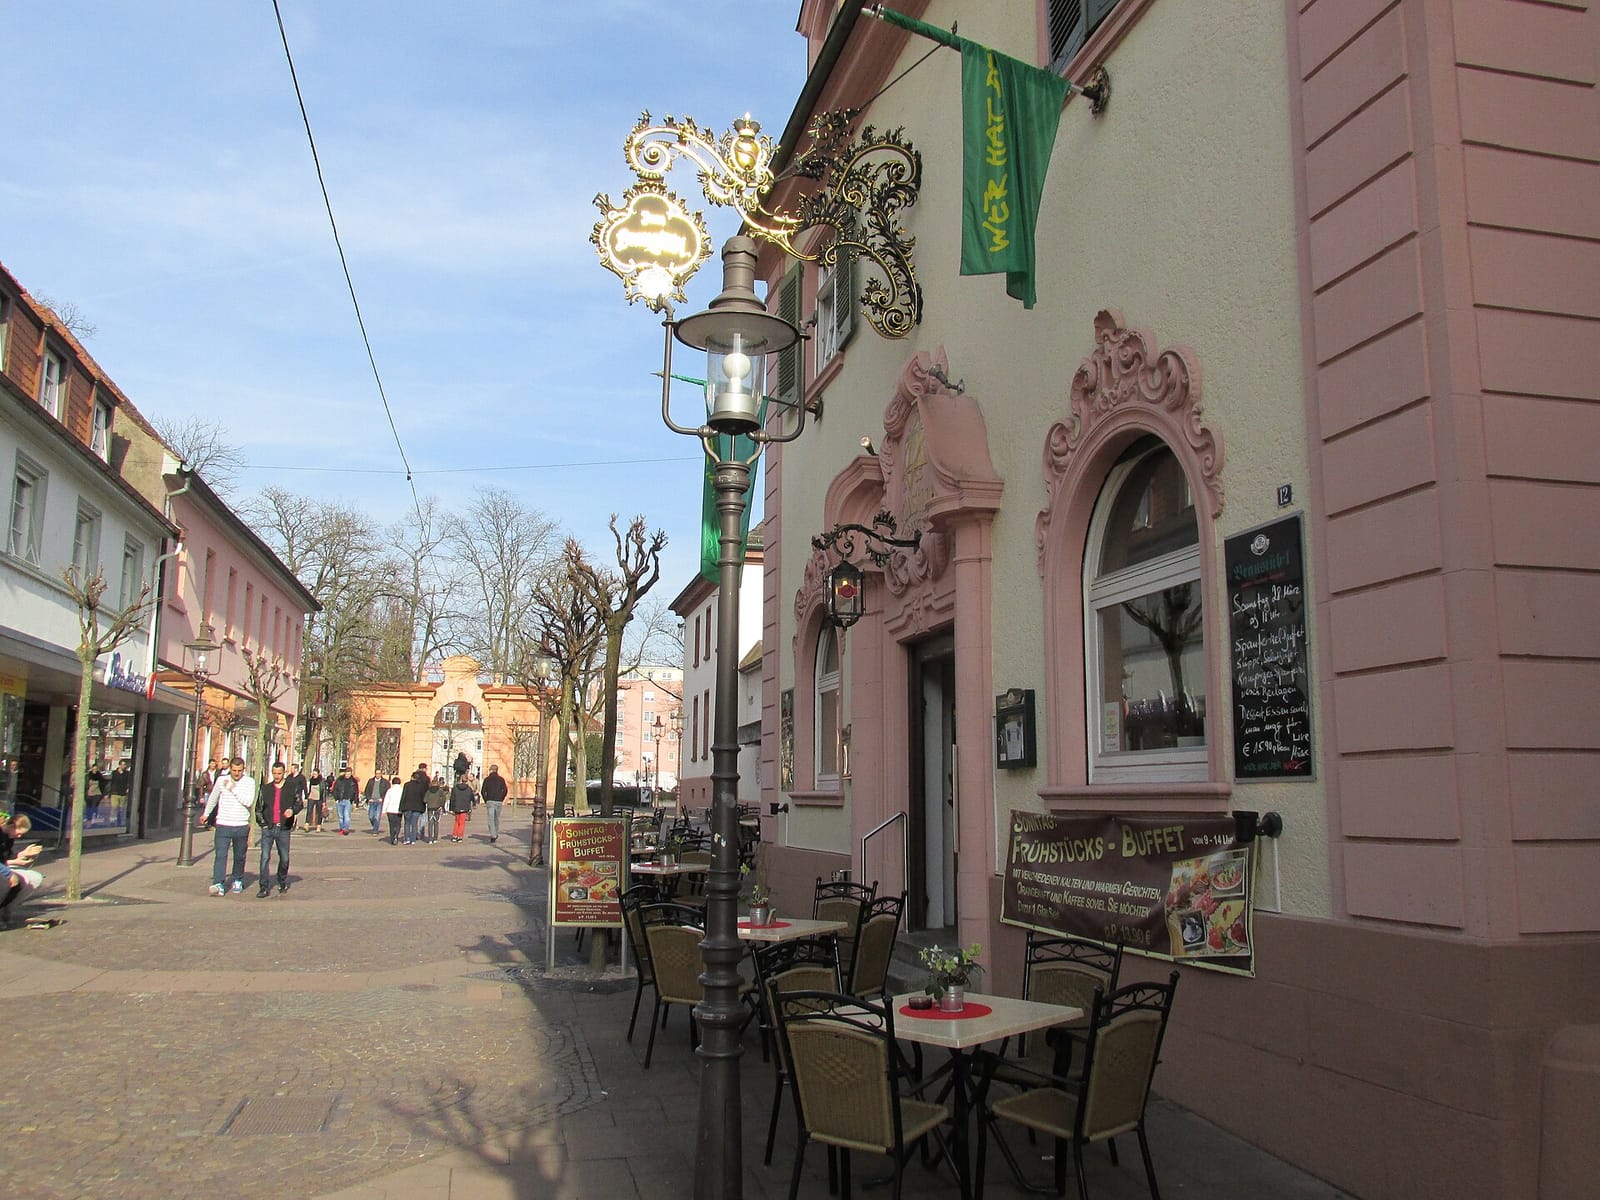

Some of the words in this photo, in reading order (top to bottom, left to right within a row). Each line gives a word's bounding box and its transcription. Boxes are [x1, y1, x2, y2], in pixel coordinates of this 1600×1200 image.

[985, 98, 1008, 166] HAT
[982, 173, 1010, 253] WER
[1279, 487, 1289, 504] 12
[573, 846, 605, 858] BUFFET
[1121, 824, 1186, 858] BUFFET
[1213, 834, 1222, 845] 14
[1060, 876, 1082, 889] KALTEN
[1081, 880, 1095, 891] UND
[1095, 881, 1123, 895] WARMEN
[1122, 880, 1162, 903] GERICHTEN,
[1050, 891, 1062, 903] UND
[1062, 890, 1086, 907] KAFFEE
[1085, 897, 1106, 911] SOVIEL
[1107, 896, 1119, 913] SIE
[1119, 901, 1152, 919] MÖCHTEN
